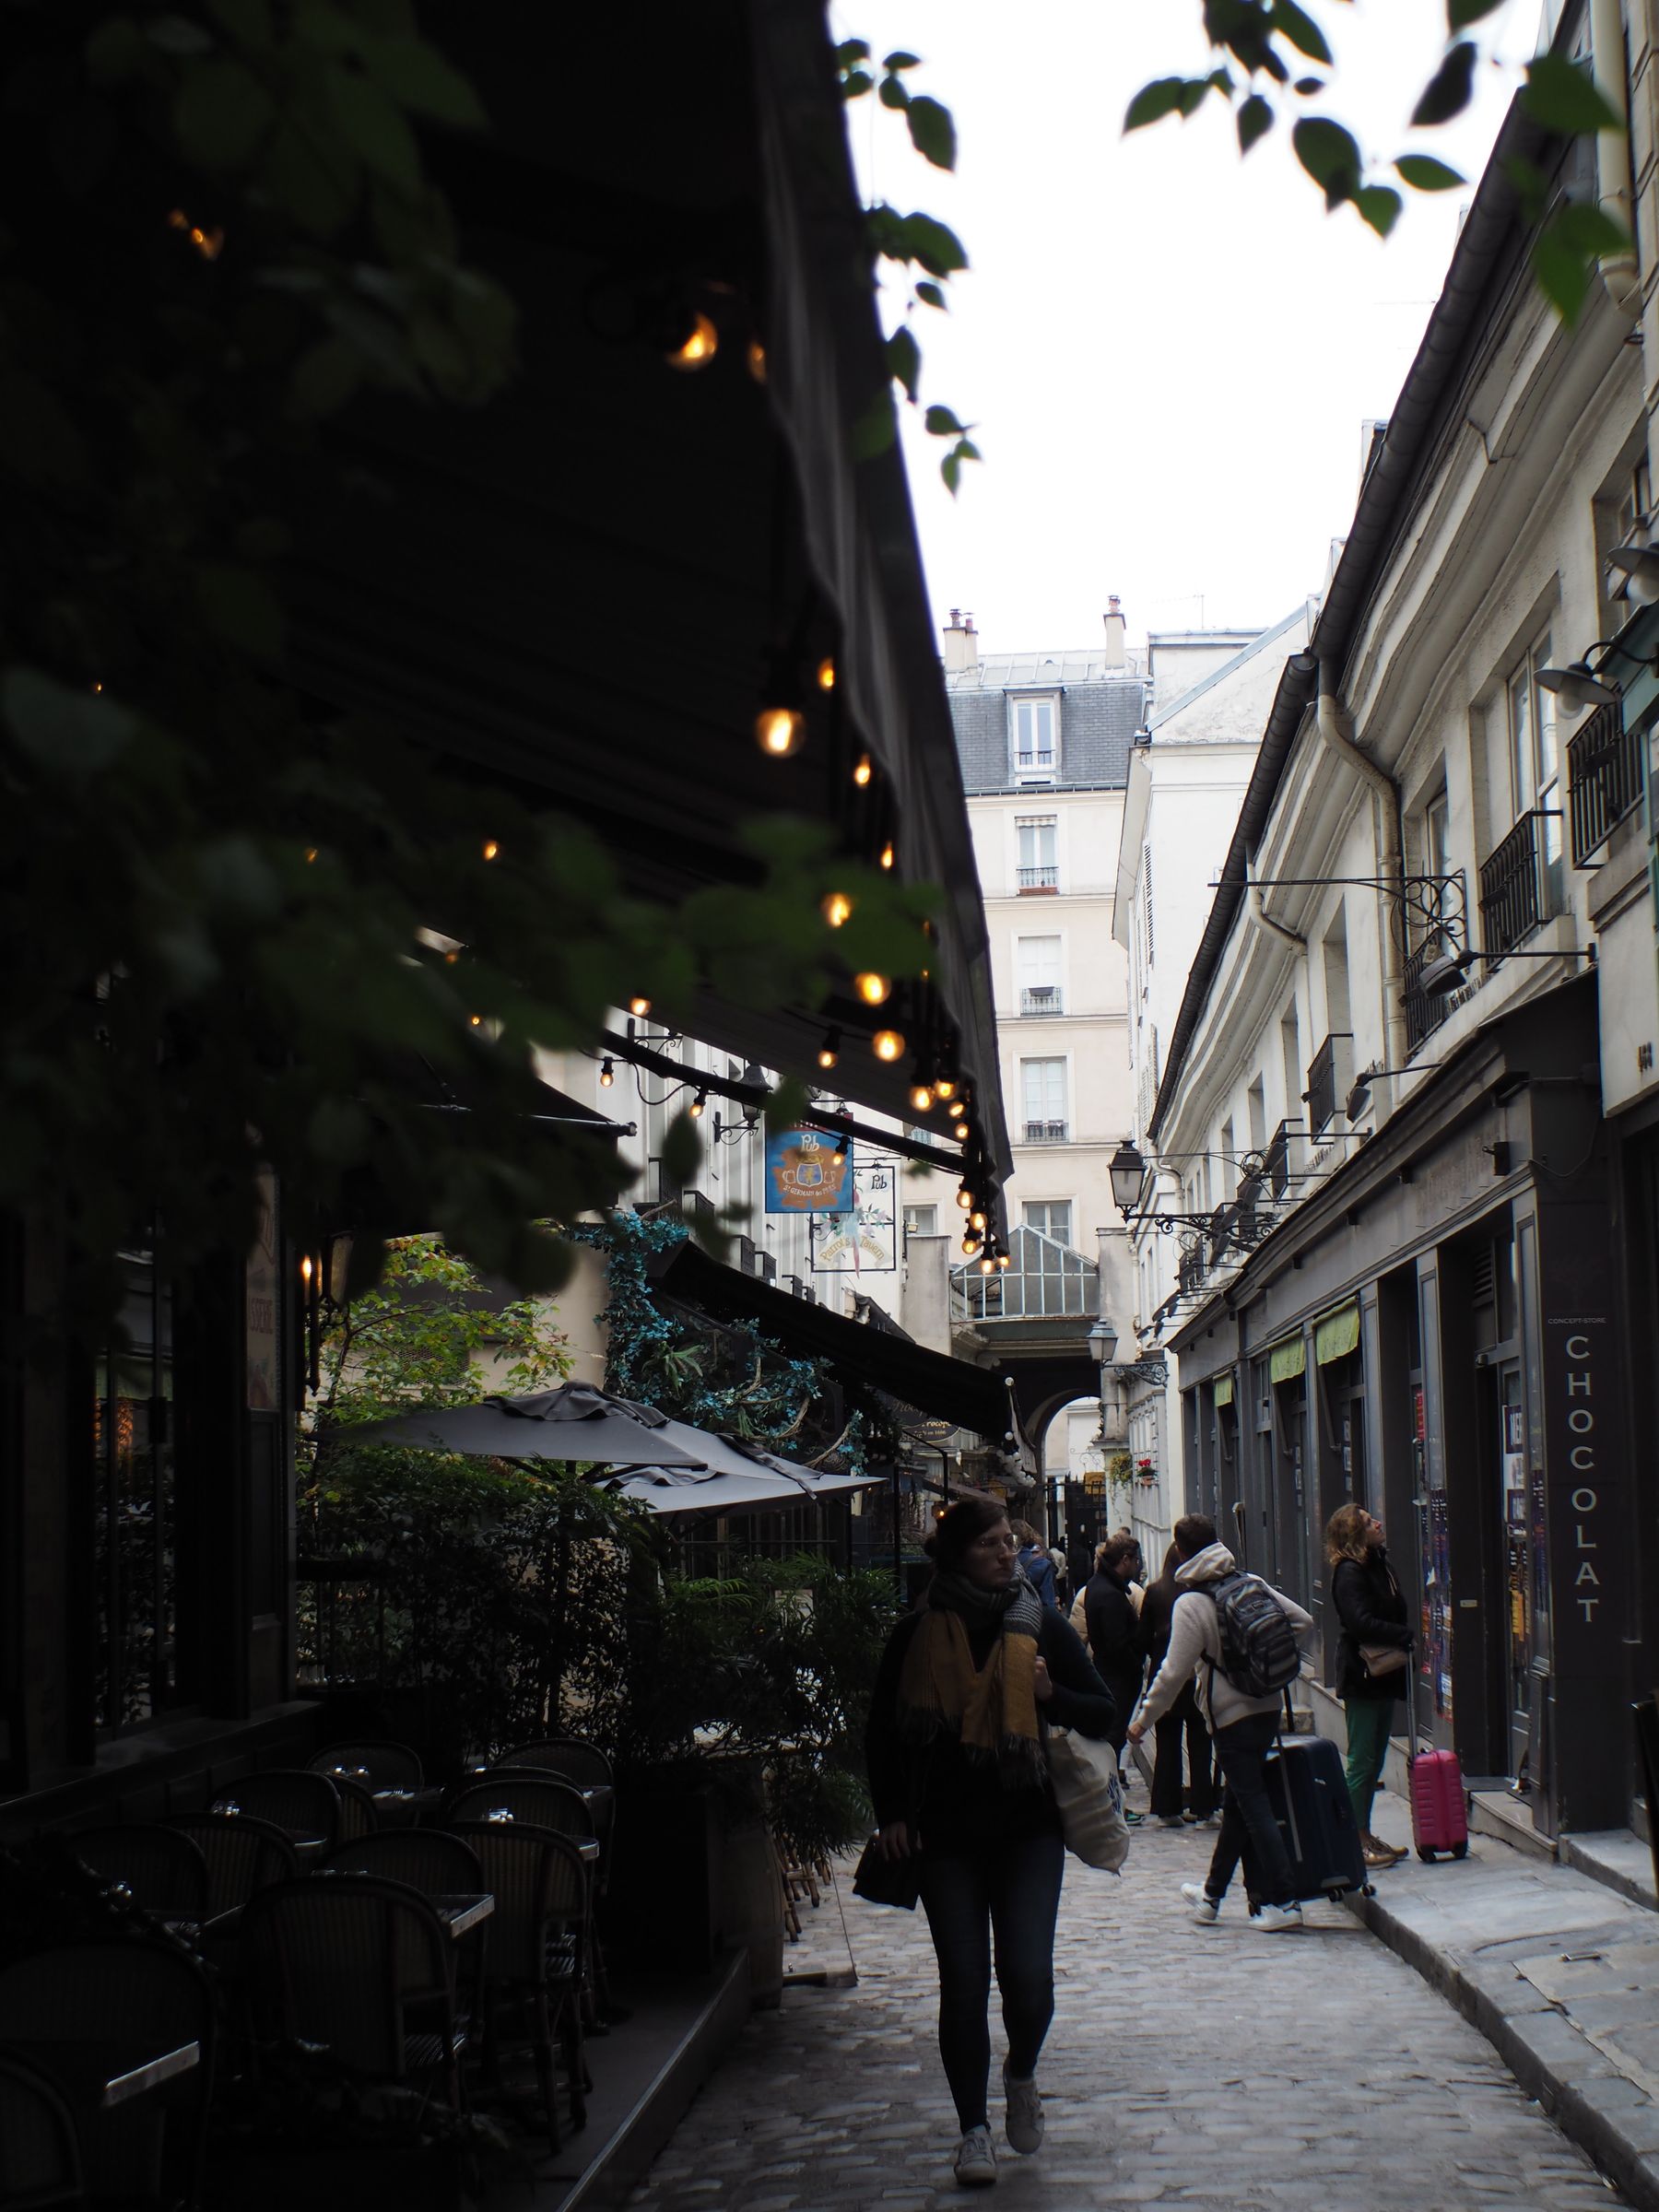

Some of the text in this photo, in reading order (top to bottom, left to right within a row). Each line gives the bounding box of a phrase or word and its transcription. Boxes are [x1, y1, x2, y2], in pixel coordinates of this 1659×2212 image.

[801, 1134, 820, 1152] Pub
[871, 1174, 888, 1190] Pub
[791, 1187, 815, 1196] GERMAIN
[861, 1236, 884, 1260] Tavern
[1565, 1335, 1602, 1623] CHOCOLAT
